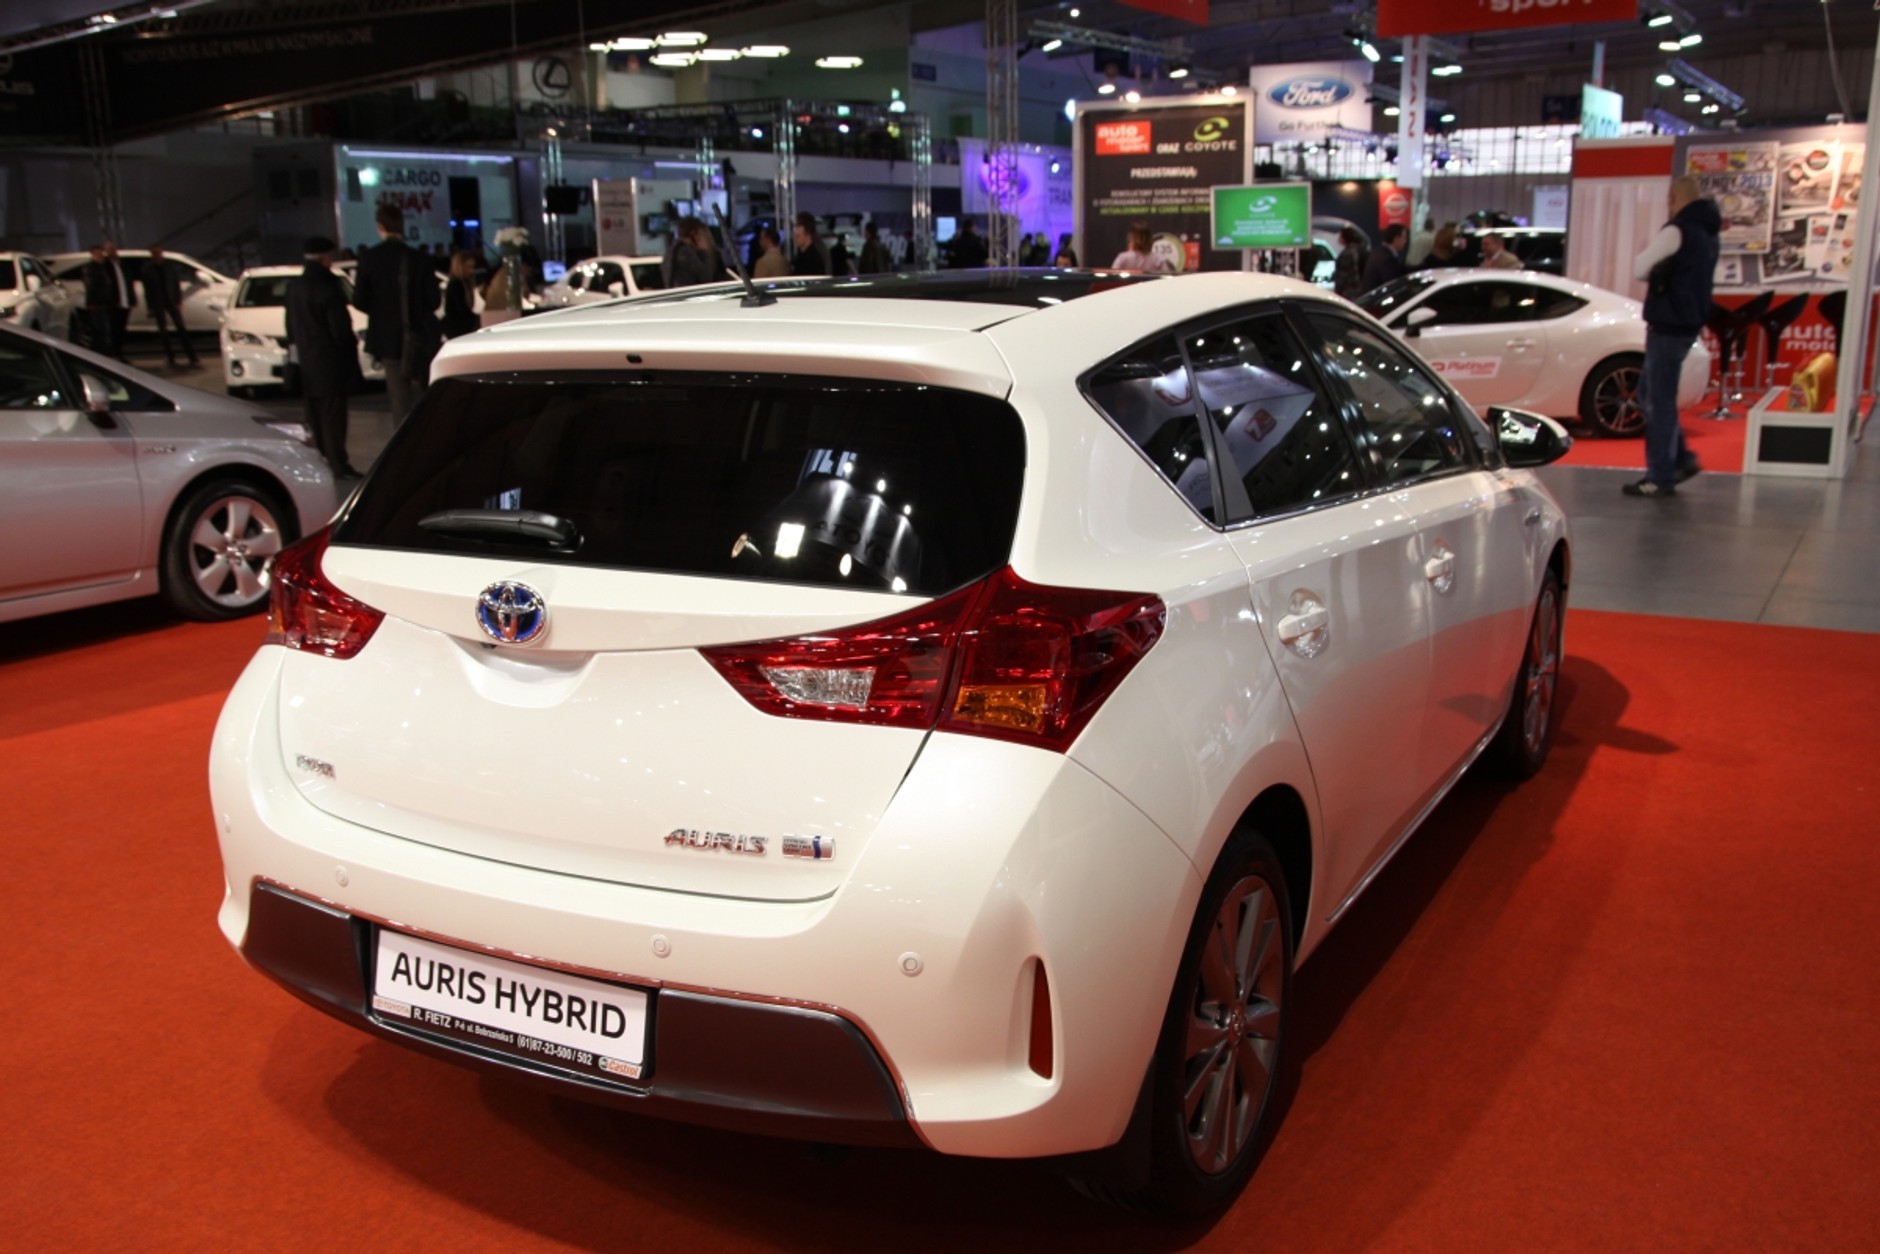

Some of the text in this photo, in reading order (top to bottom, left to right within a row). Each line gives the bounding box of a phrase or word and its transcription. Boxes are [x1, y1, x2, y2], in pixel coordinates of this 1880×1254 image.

[1282, 79, 1337, 106] Ford
[1098, 125, 1138, 138] auto
[1156, 140, 1237, 154] ORAZ COYOTE
[383, 169, 441, 187] CARGO
[664, 828, 769, 858] AURIS
[391, 952, 627, 1039] AURIS HYBRID
[413, 1007, 423, 1020] R.
[425, 1010, 452, 1028] FIETZ
[577, 1051, 593, 1066] 502
[607, 1061, 639, 1077] Castrol
